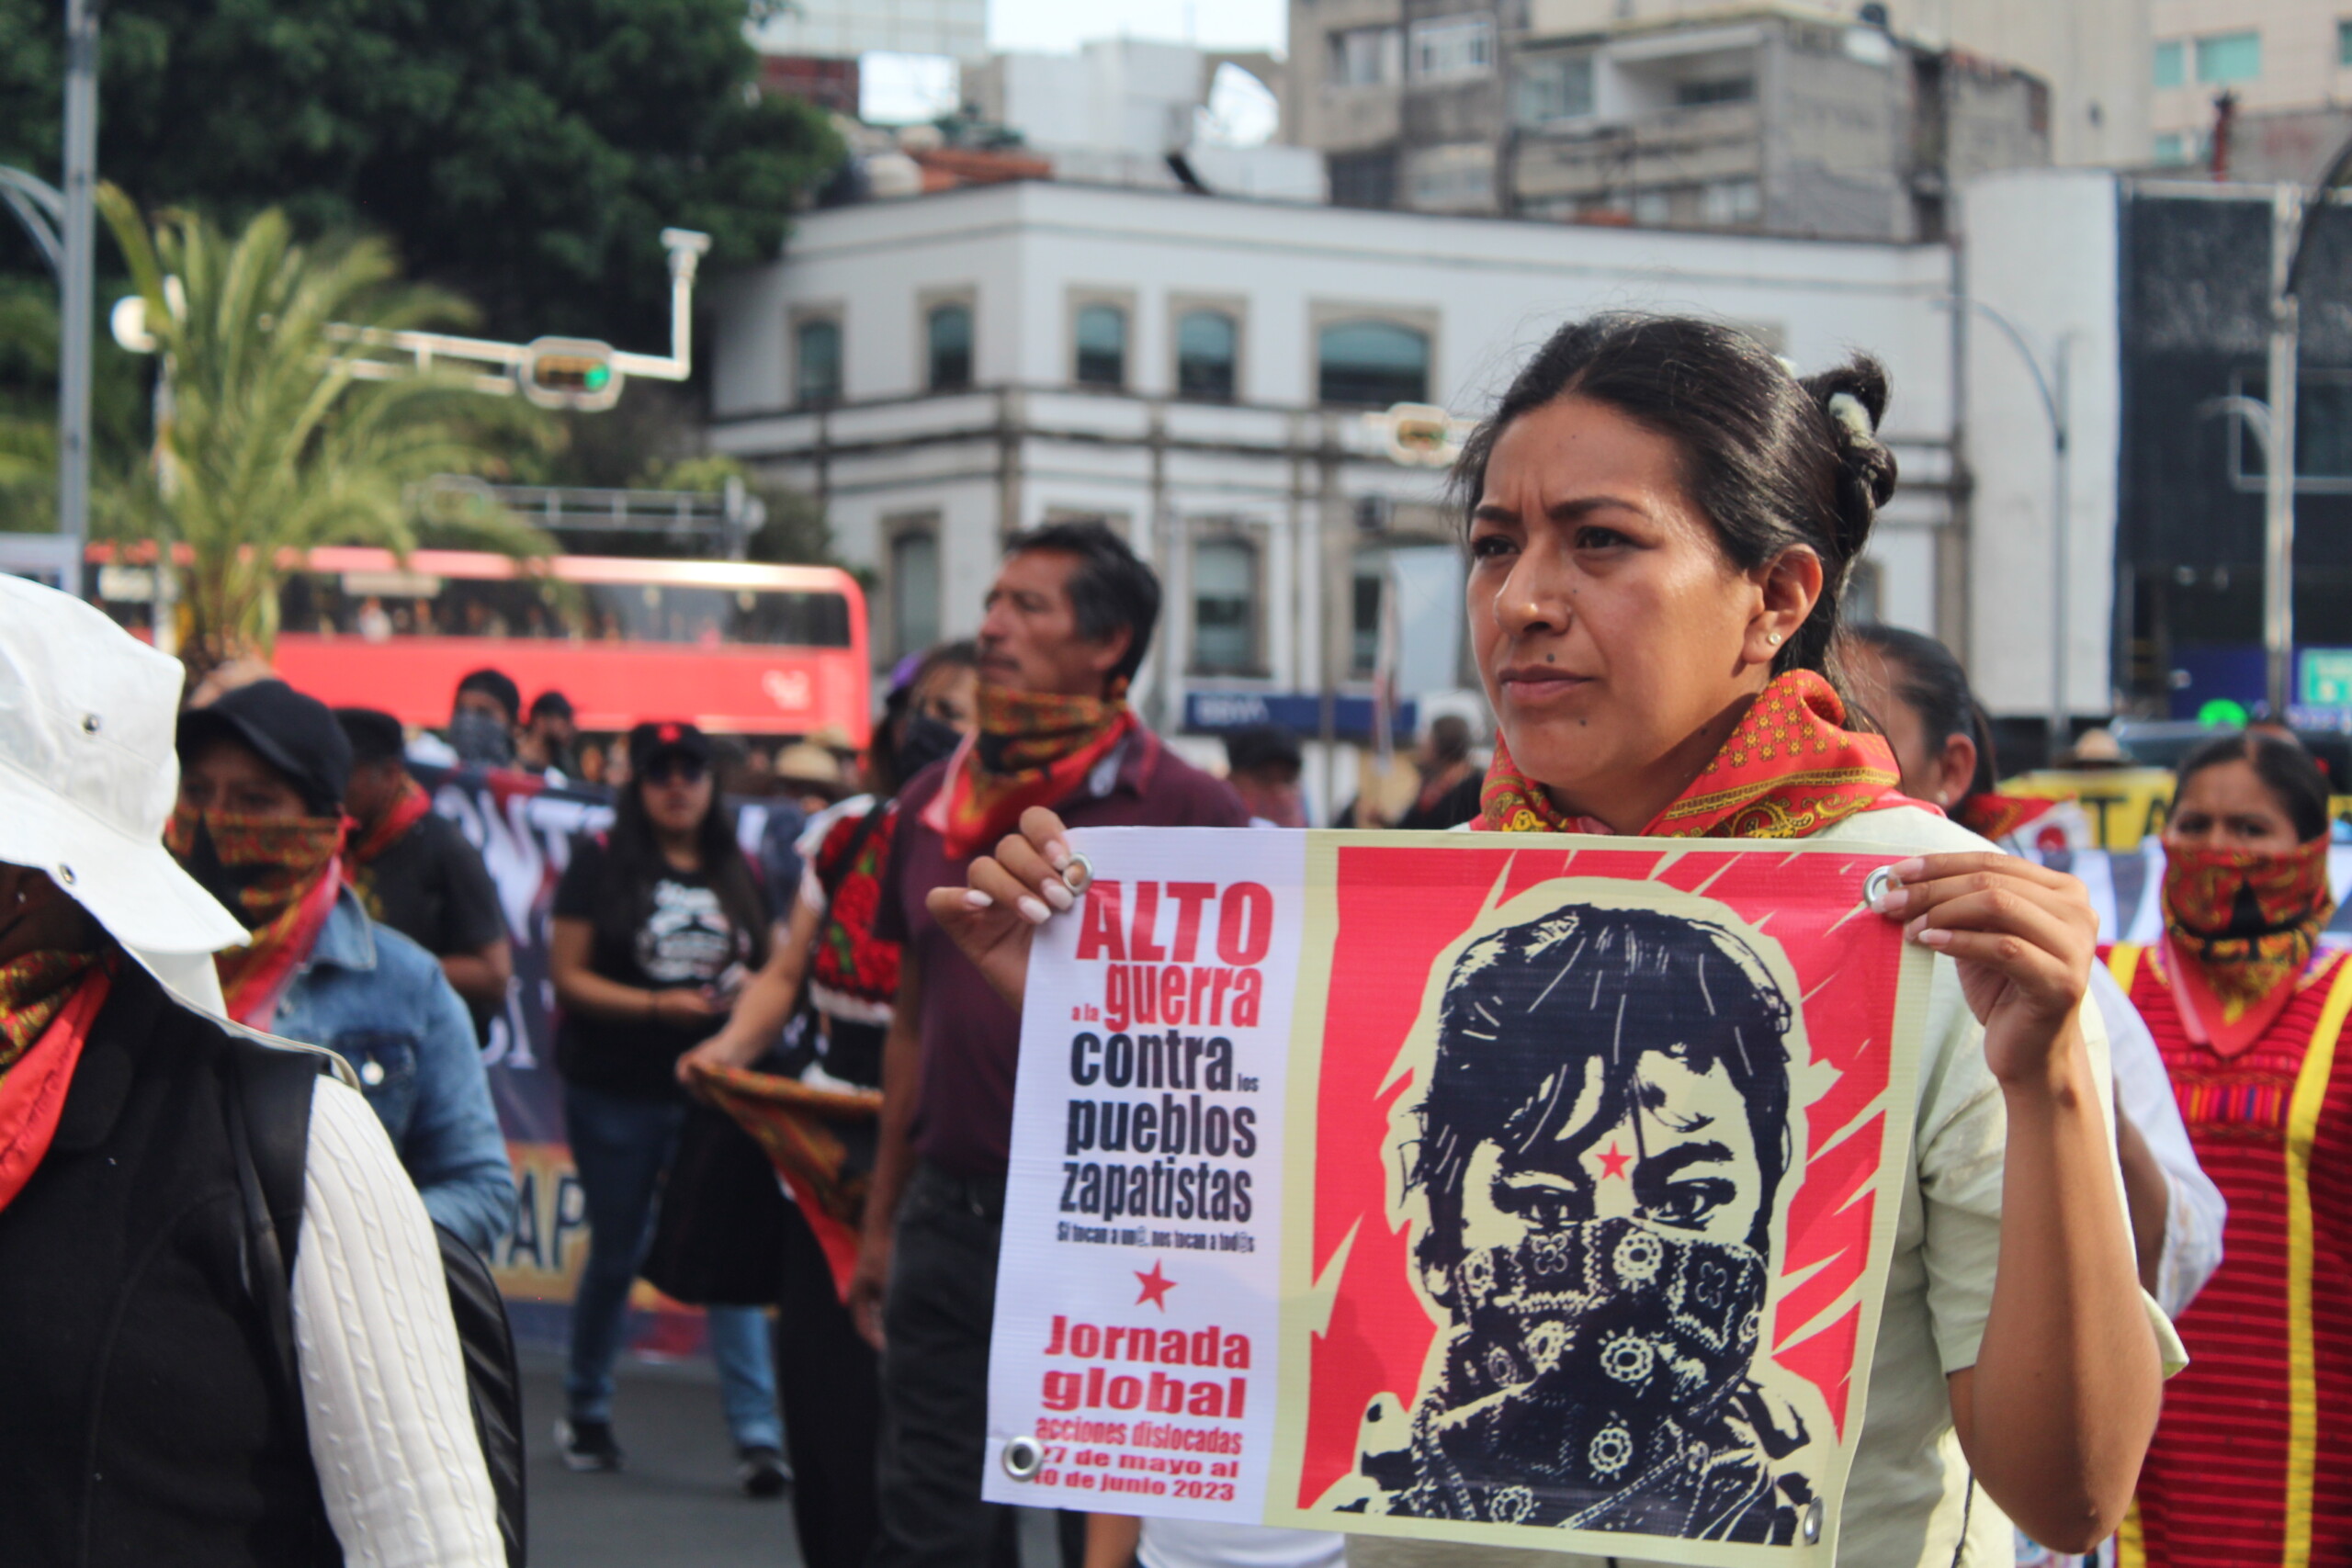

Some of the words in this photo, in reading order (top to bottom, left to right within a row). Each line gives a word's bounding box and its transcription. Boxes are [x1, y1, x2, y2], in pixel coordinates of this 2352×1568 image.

[1076, 880, 1274, 966] ALTO
[1071, 1007, 1080, 1021] a
[1084, 1005, 1099, 1021] la
[1103, 963, 1263, 1032] guerra
[1070, 1030, 1233, 1091] contra
[1238, 1074, 1259, 1092] los
[1067, 1094, 1257, 1158] pueblos
[1058, 1156, 1252, 1223] zapatistas
[1073, 1224, 1107, 1244] tocan
[1112, 1228, 1117, 1245] a
[1175, 1231, 1206, 1250] tocan
[1210, 1235, 1216, 1250] a
[1044, 1315, 1251, 1370] Jornada
[1041, 1368, 1247, 1418] global
[1035, 1416, 1126, 1445] acciones
[1132, 1420, 1243, 1455] dislocadas
[1065, 1472, 1095, 1488] de
[1101, 1473, 1166, 1495] junio
[1173, 1479, 1235, 1501] 2023
[1075, 1450, 1110, 1466] de
[1119, 1454, 1203, 1475] mayo
[1210, 1461, 1239, 1478] al
